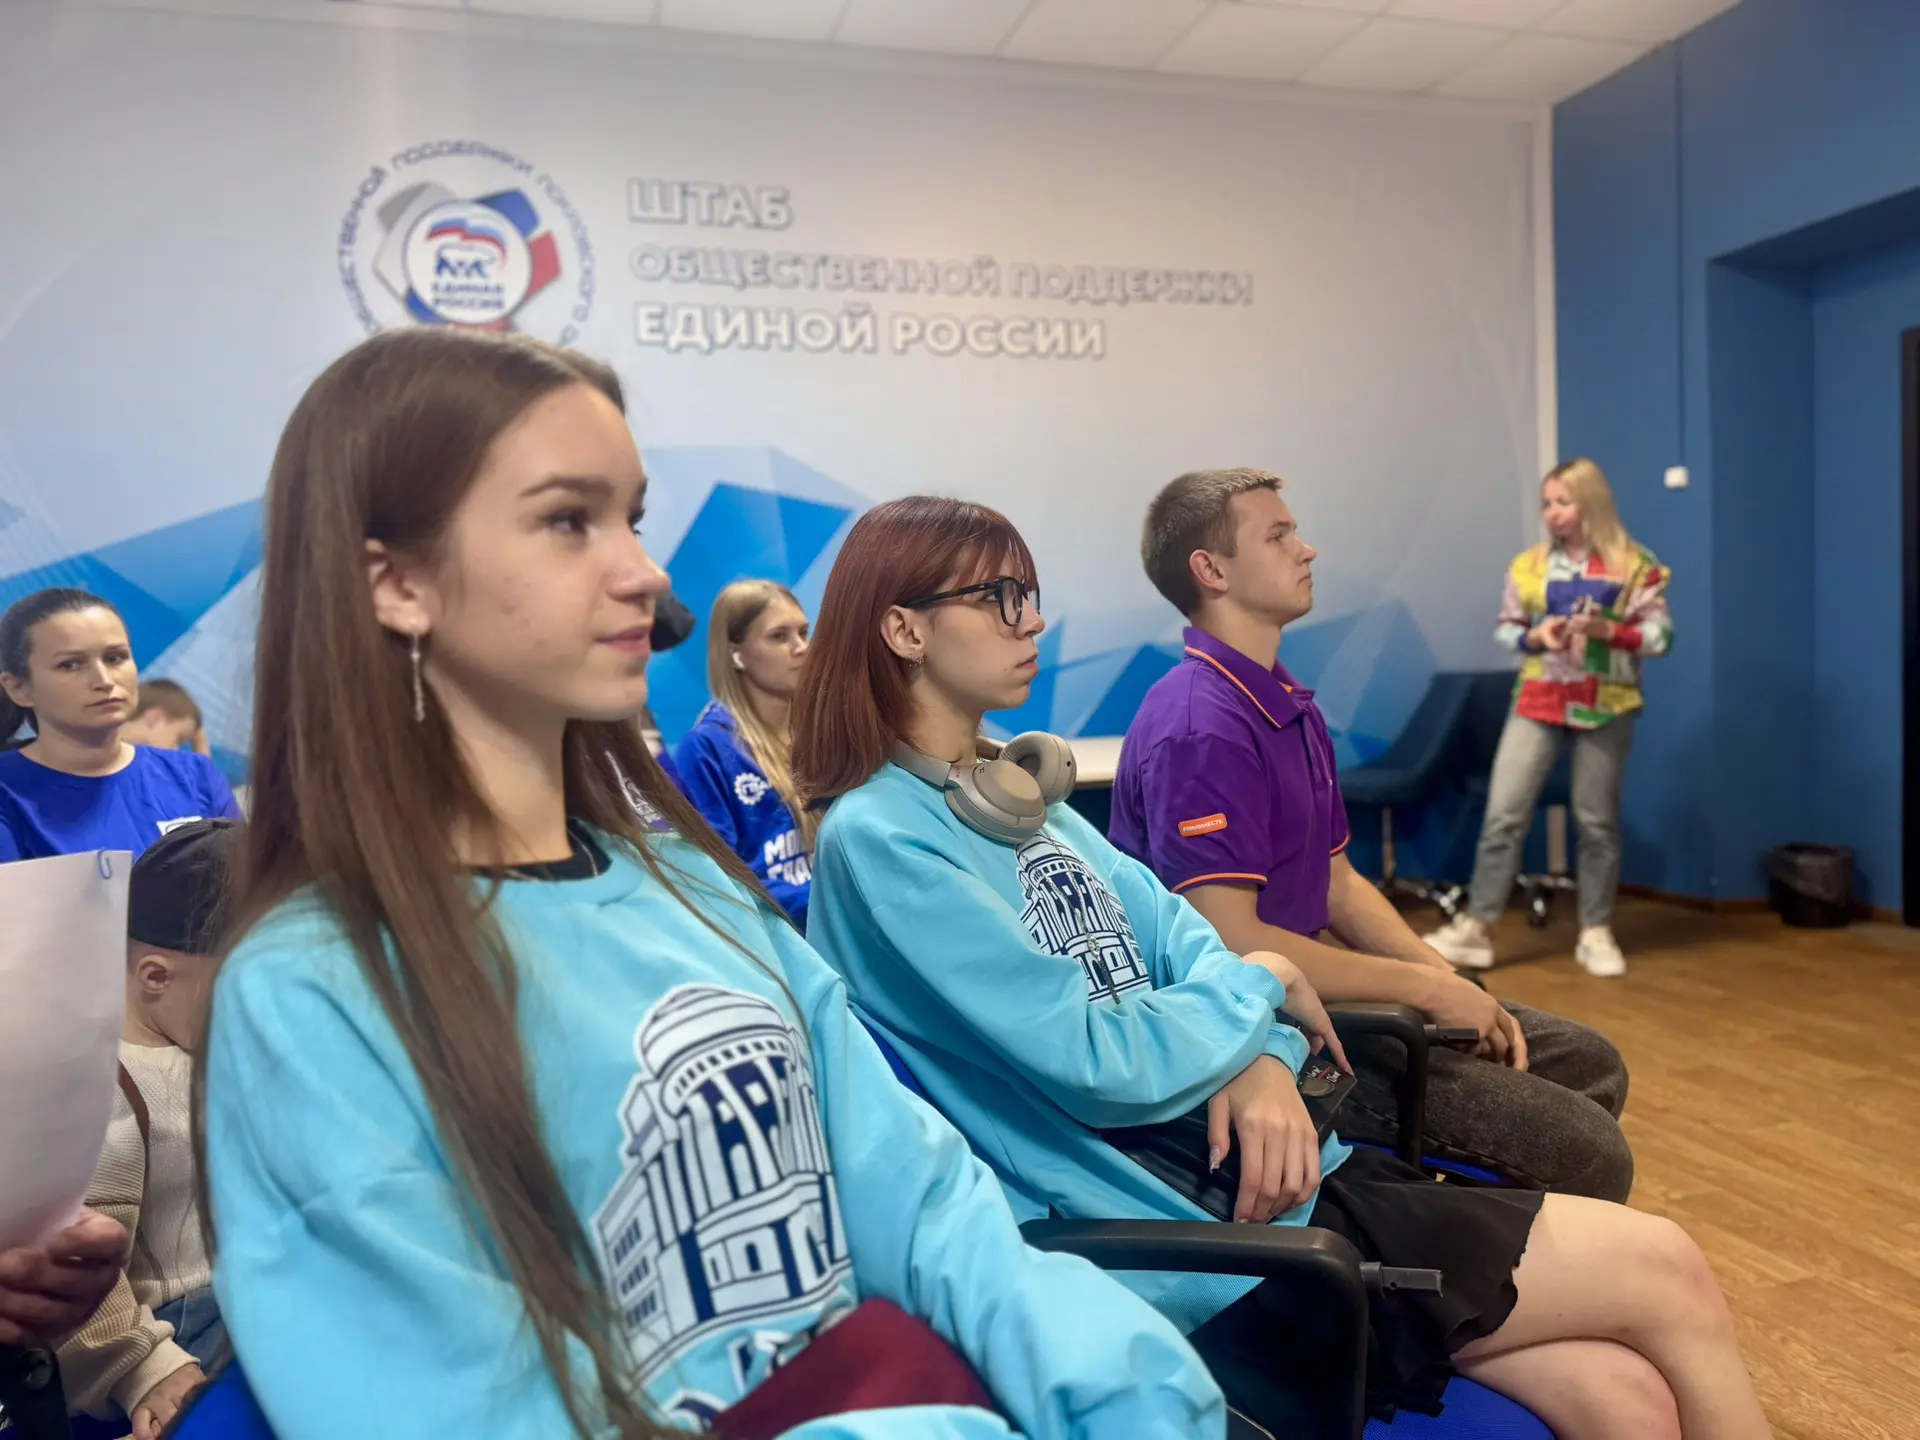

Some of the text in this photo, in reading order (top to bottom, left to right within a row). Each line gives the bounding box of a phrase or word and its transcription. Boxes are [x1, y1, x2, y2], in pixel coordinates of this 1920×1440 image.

[628, 179, 793, 230] ШТАБ
[629, 245, 1254, 306] ОБЩЕСТВЕННОЙ ПОДДЕРЖКИ
[635, 303, 876, 354] ЕДИНОЙ
[892, 312, 1106, 359] РОССИИ
[764, 829, 802, 866] МО
[767, 856, 812, 886] ГВА
